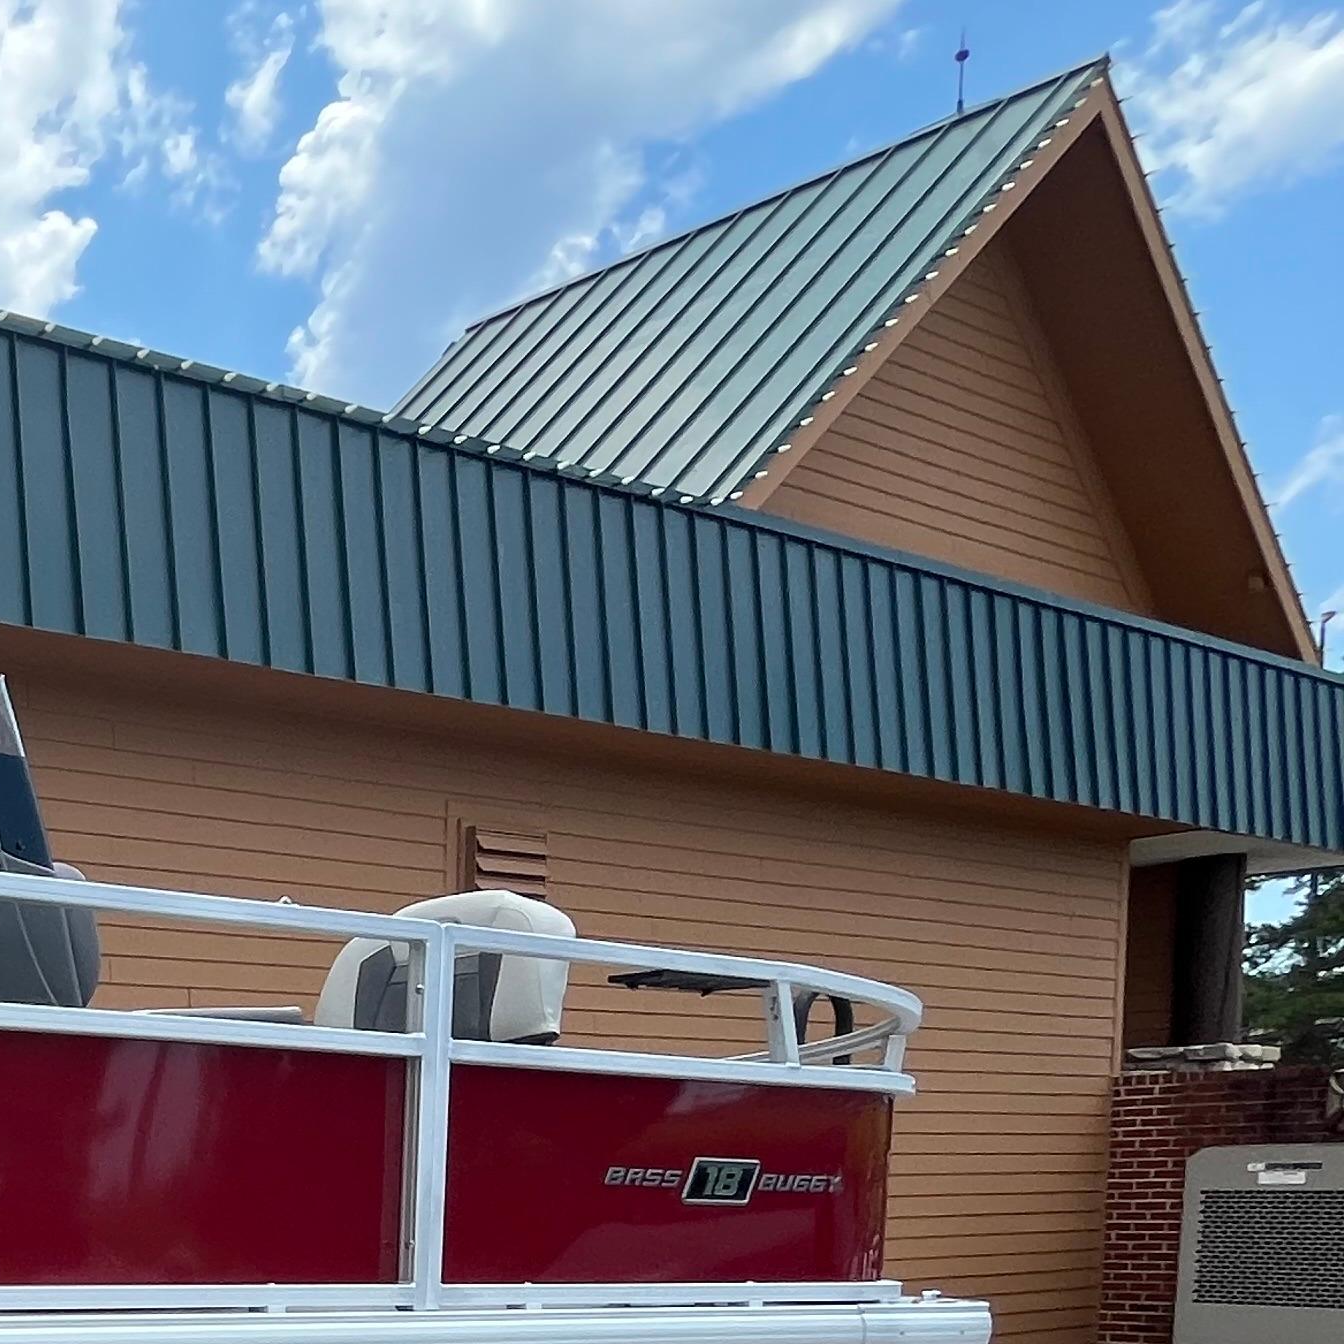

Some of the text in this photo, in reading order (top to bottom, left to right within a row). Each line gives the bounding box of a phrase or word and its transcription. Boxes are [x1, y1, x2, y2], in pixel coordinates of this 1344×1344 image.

[605, 1166, 842, 1196] BASS 18 BUGGY
